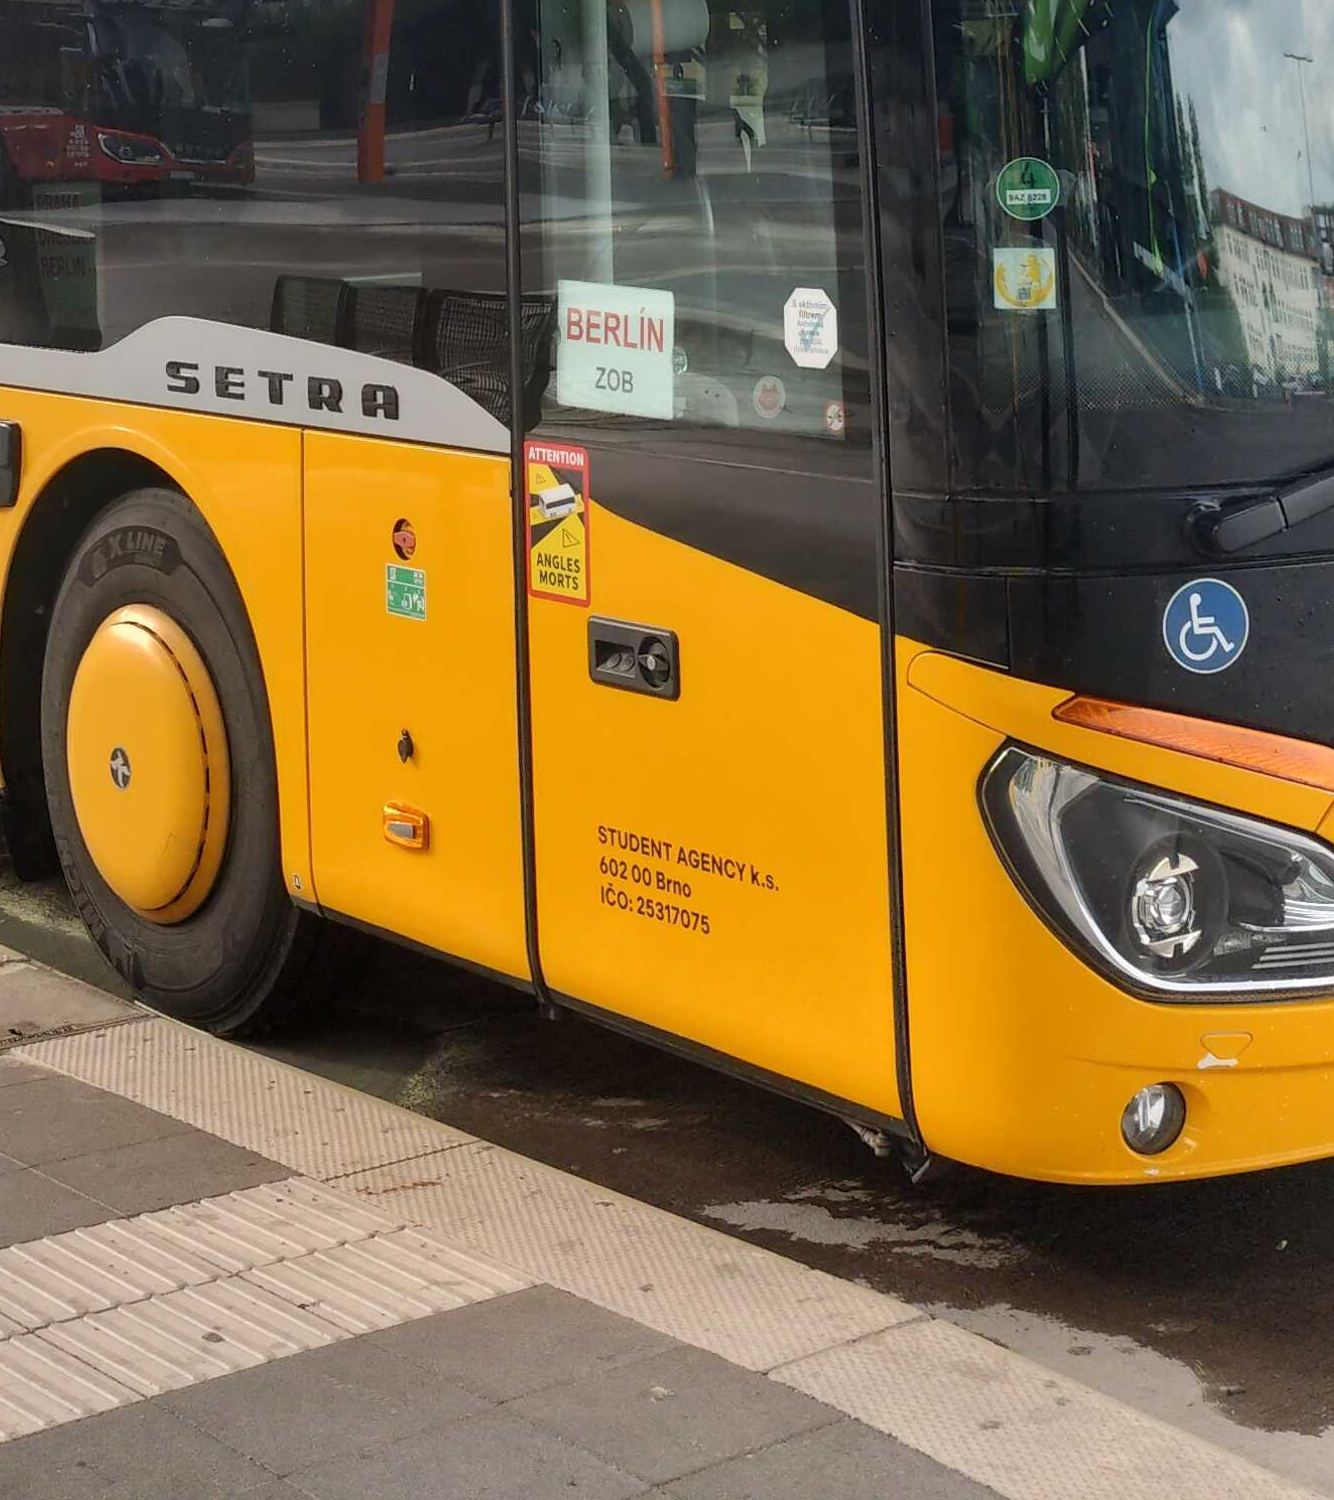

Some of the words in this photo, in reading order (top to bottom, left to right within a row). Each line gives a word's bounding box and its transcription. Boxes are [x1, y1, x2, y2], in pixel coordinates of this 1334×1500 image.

[567, 306, 665, 353] BERLÍN
[165, 360, 400, 421] SETRA
[595, 366, 634, 394] ZOB
[528, 446, 585, 467] ATTENTION
[536, 552, 581, 574] ANGLES
[539, 569, 580, 591] MORTS
[597, 825, 673, 862] STUDENT
[677, 846, 746, 881] AGENCY
[751, 864, 780, 892] k.s.
[599, 855, 628, 880] 602
[631, 864, 652, 886] 00
[656, 871, 692, 898] Brno
[600, 883, 633, 912] IČO:
[637, 896, 711, 935] 25317075
